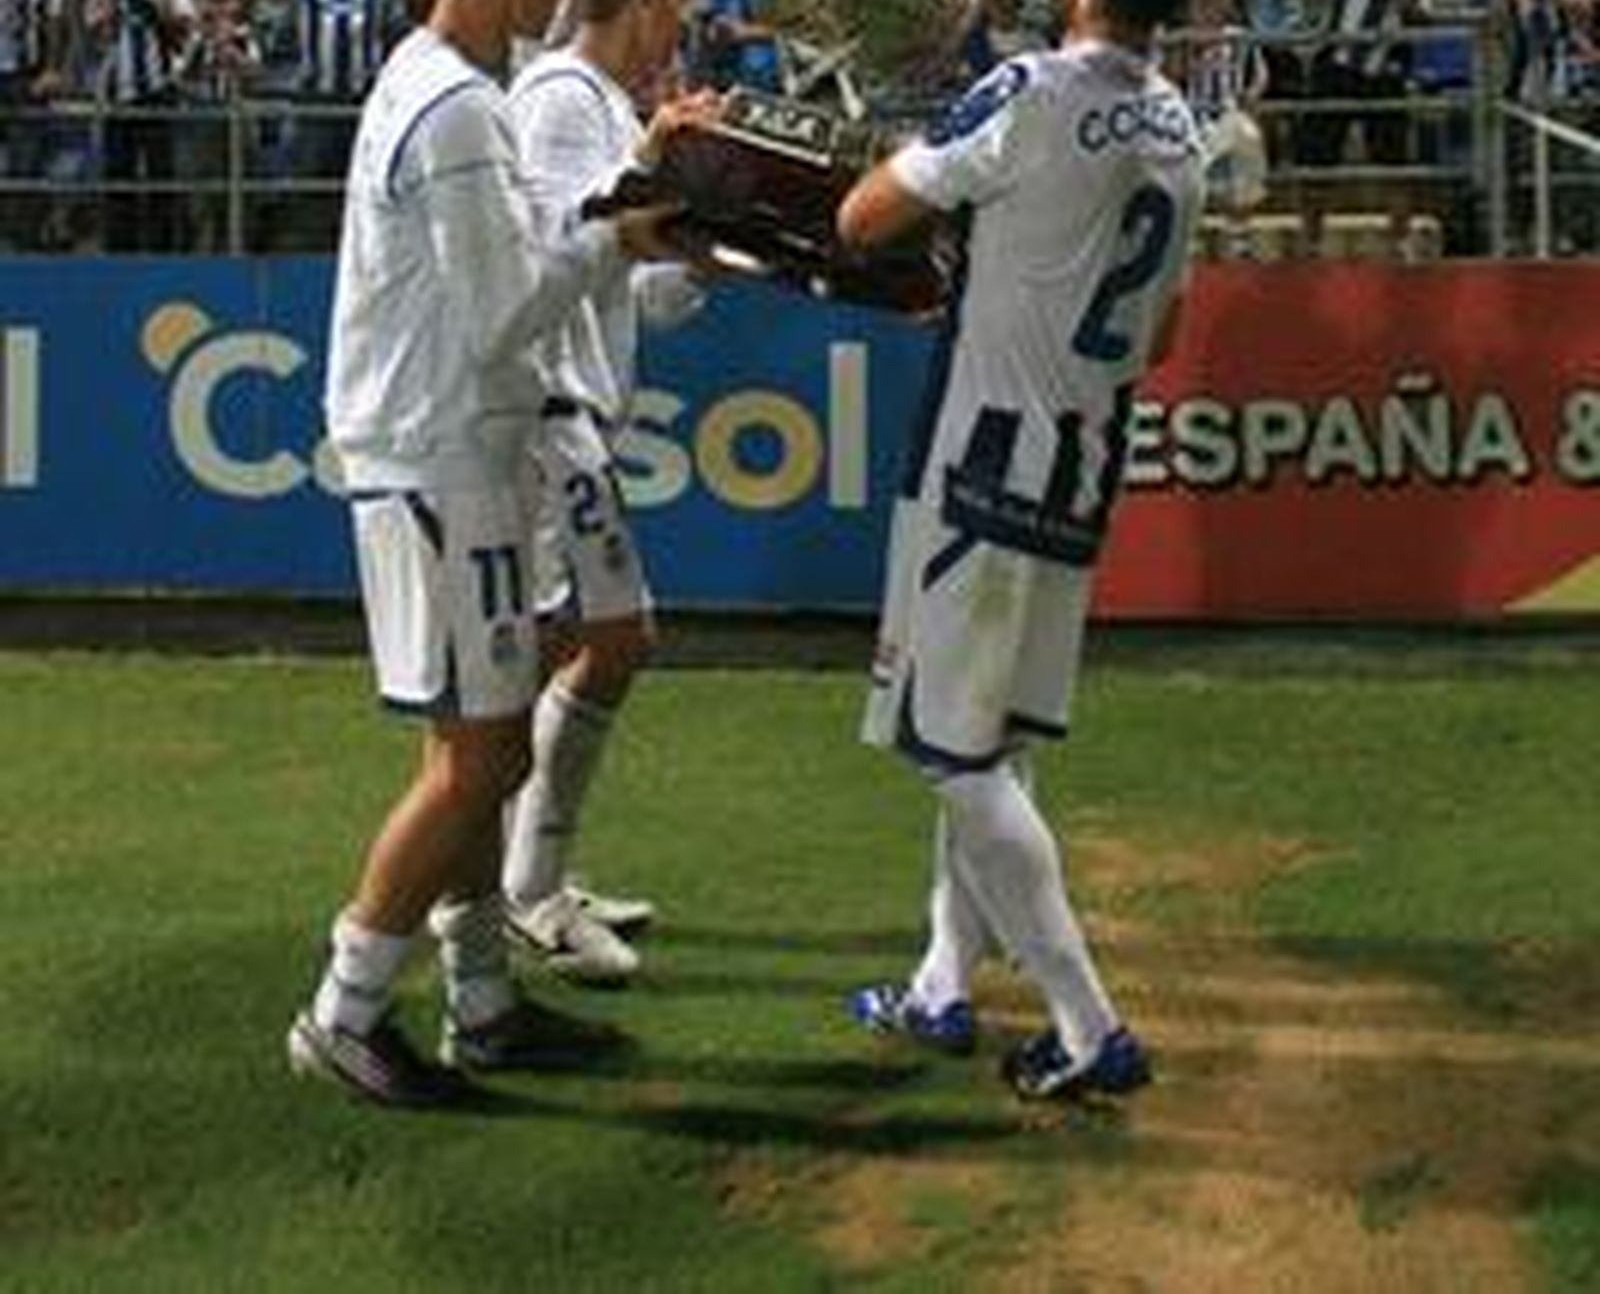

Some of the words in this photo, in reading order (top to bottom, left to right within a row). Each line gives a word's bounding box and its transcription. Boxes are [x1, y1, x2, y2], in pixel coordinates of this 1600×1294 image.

[1072, 181, 1175, 361] 2
[1124, 373, 1530, 484] ESPAÑA
[470, 545, 523, 620] 11
